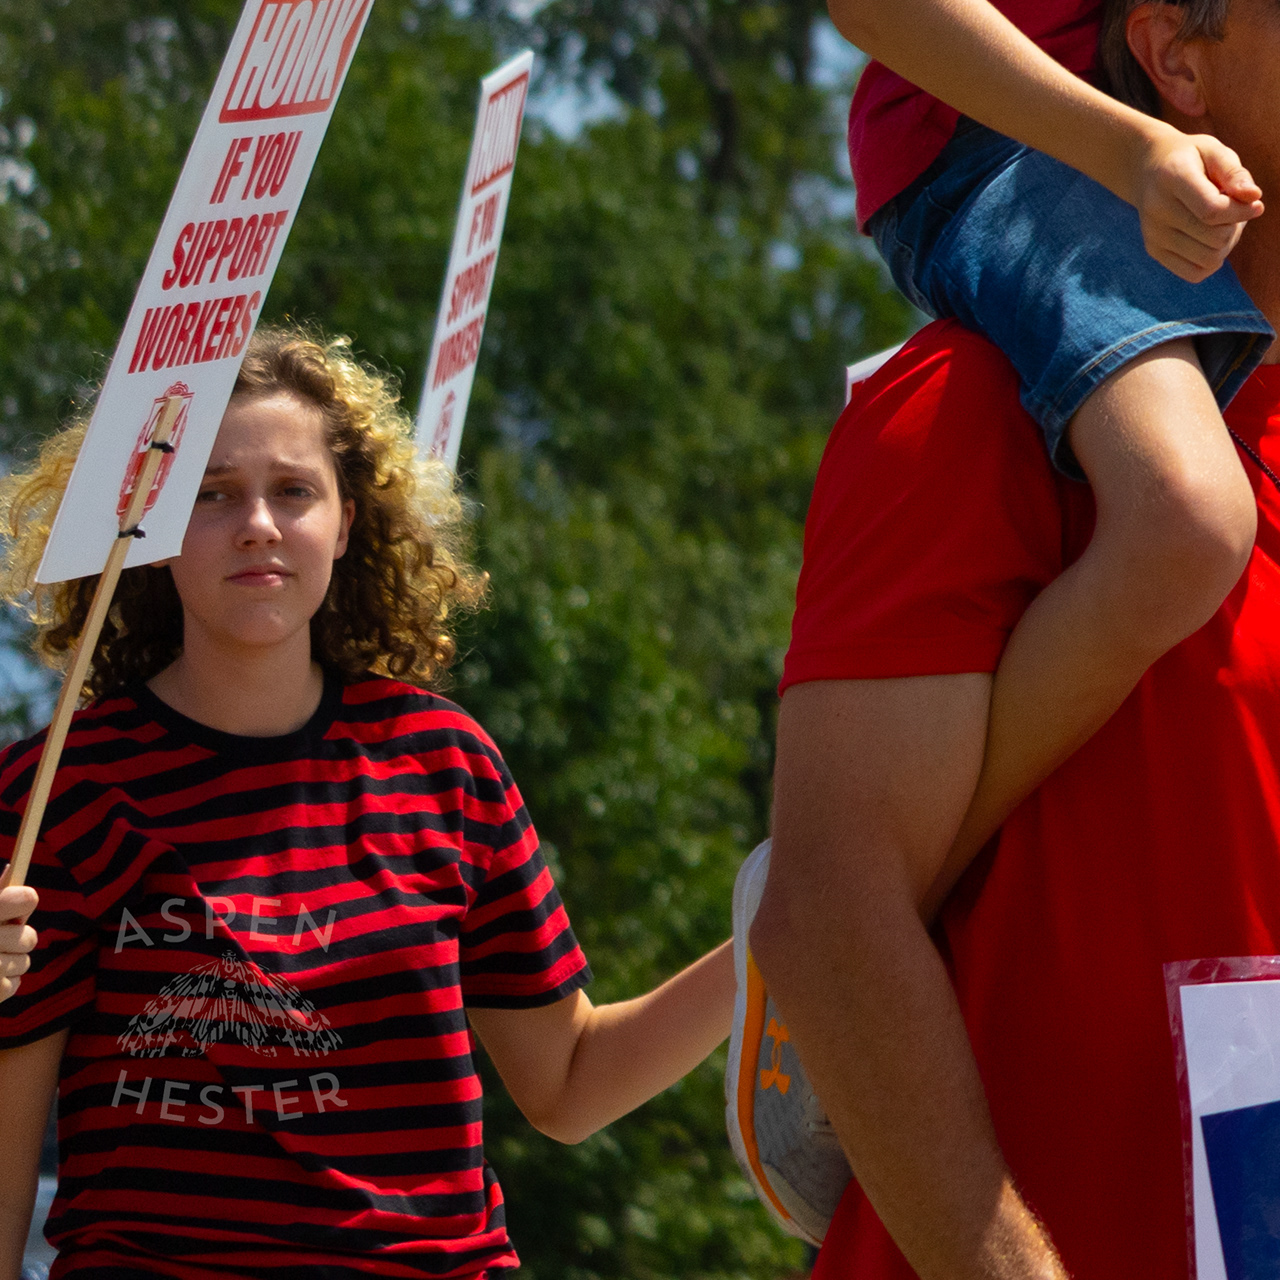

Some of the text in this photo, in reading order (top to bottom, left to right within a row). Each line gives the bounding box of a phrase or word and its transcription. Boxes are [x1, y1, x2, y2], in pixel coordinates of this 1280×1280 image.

[209, 130, 303, 204] IF YOU
[162, 210, 289, 290] SUPPORT
[128, 290, 261, 374] WORKERS
